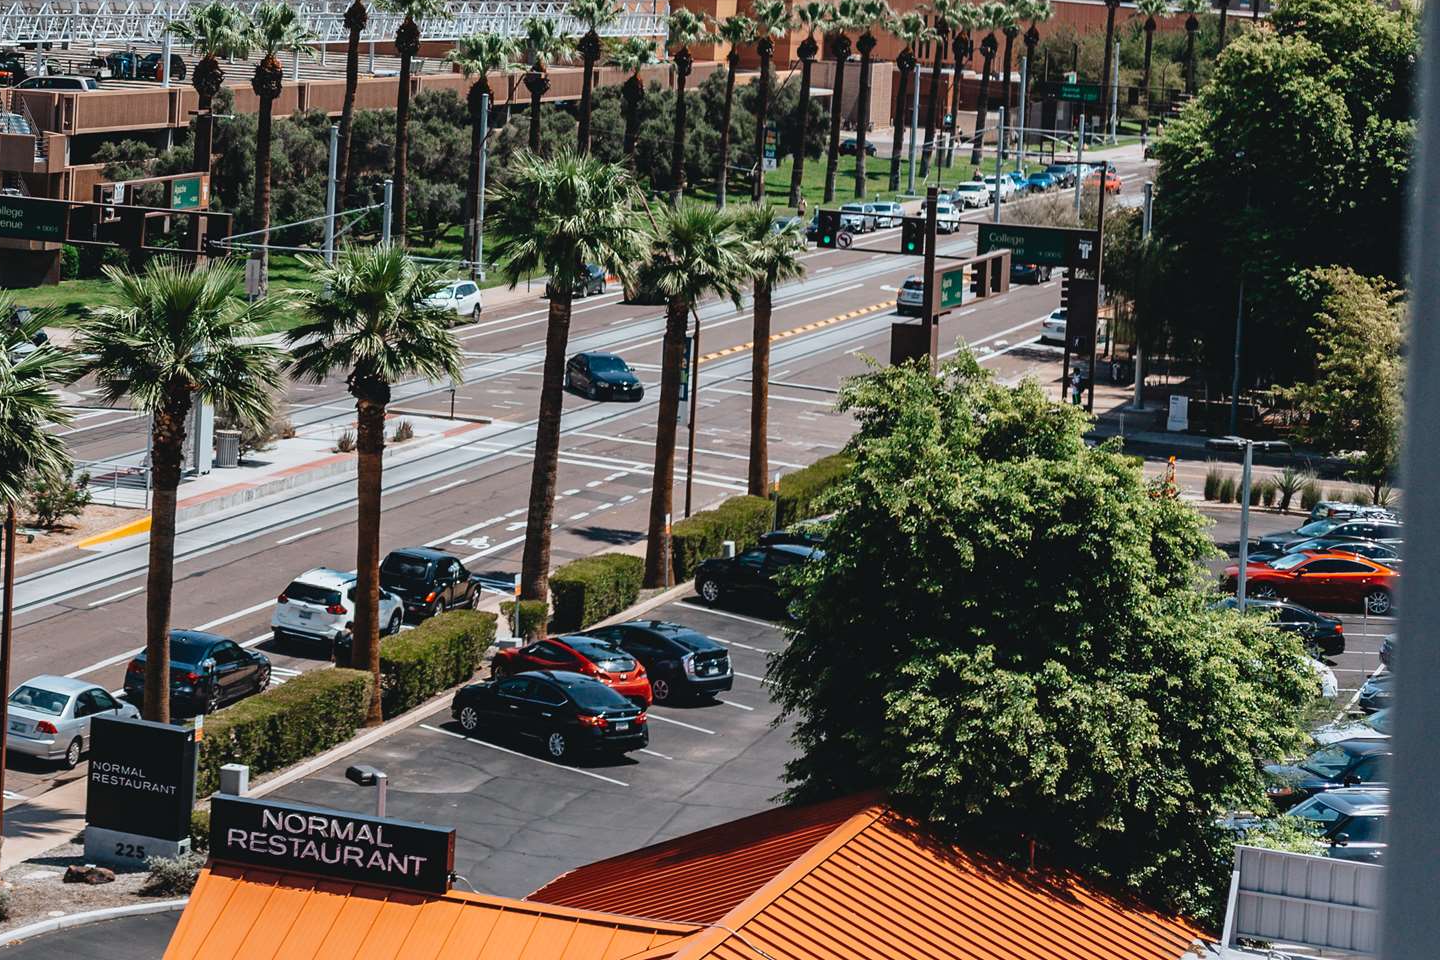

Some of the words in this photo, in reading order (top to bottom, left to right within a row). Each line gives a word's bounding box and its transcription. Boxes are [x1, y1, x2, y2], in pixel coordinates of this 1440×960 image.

[989, 232, 1025, 245] College
[92, 761, 146, 778] NORMAL
[91, 772, 177, 795] RESTAURANT
[262, 809, 392, 848] NORMAL
[115, 843, 145, 859] 225
[227, 828, 427, 876] RESTAURANT
